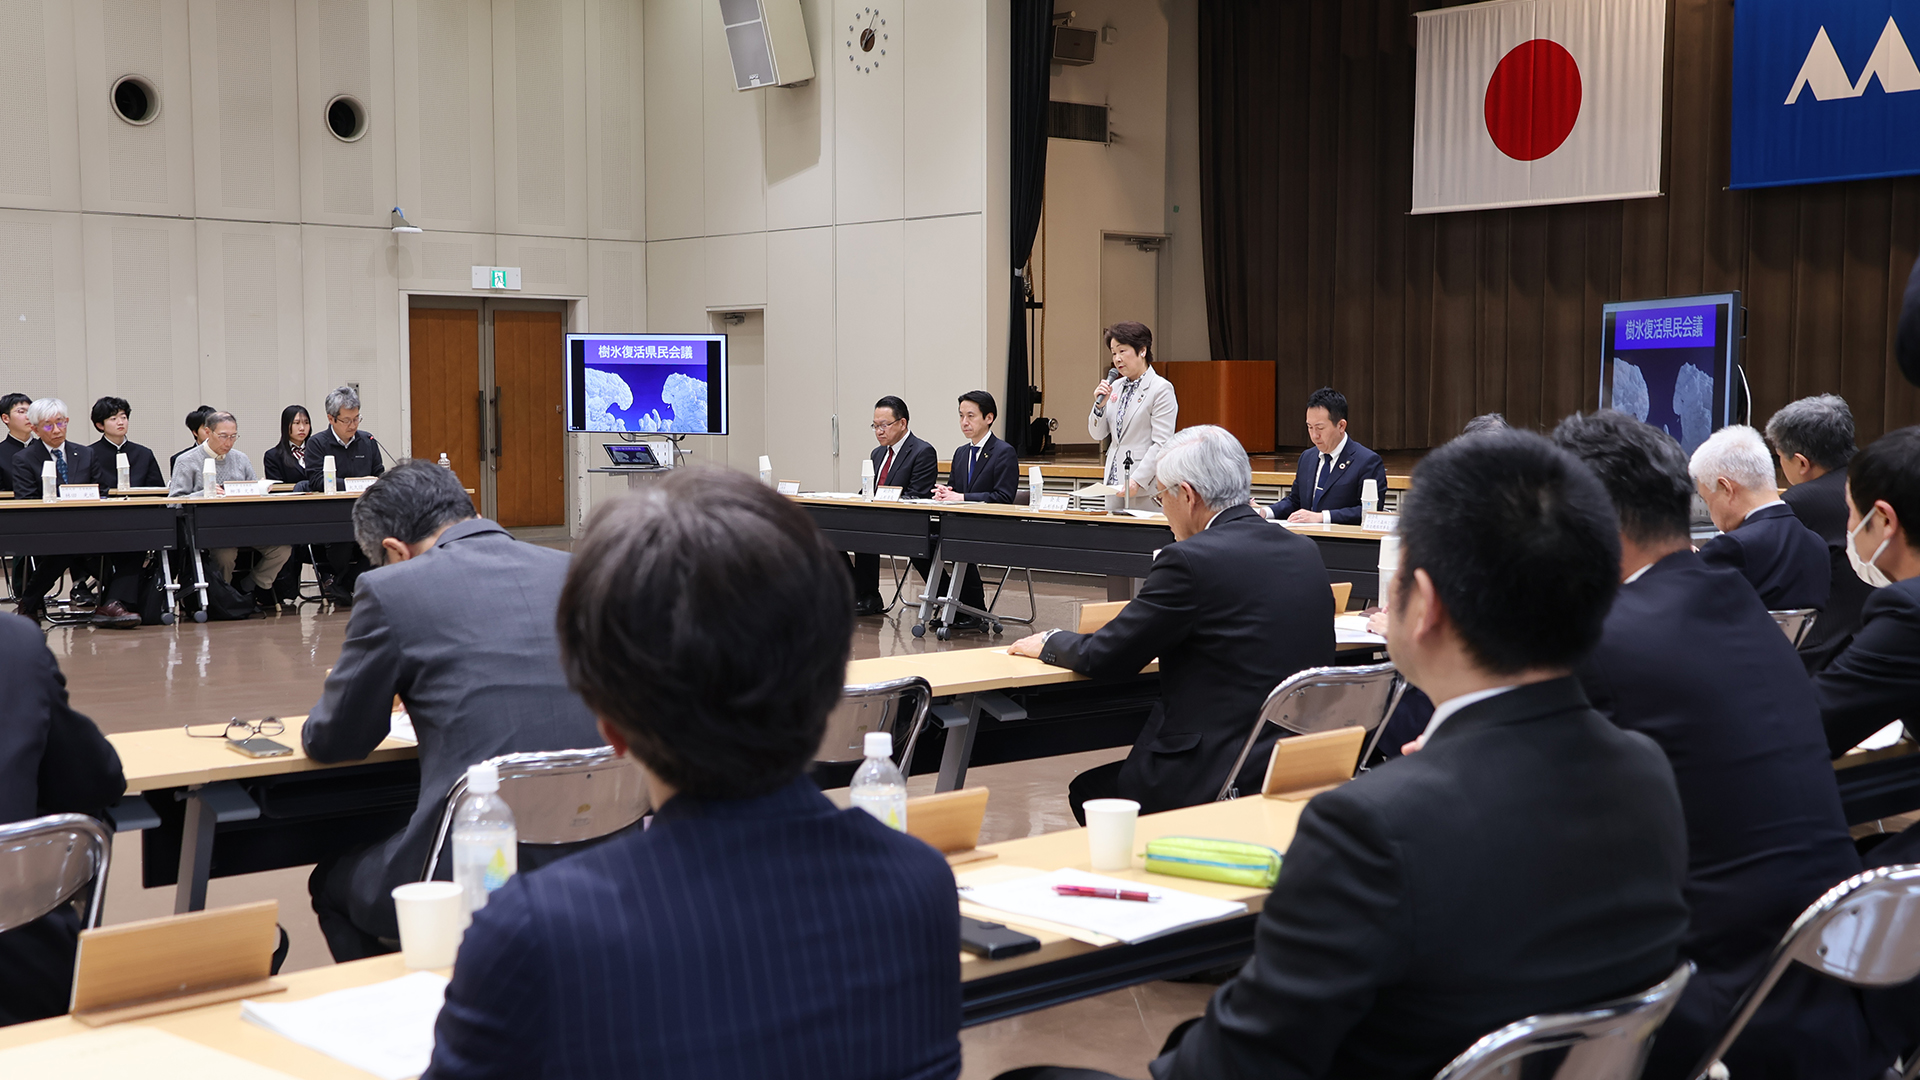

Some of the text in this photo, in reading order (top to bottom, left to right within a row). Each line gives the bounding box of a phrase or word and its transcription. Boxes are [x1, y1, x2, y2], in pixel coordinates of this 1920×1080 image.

[1625, 315, 1704, 341] 樹氷復活県民会議
[598, 345, 693, 360] 樹氷復活県民会議
